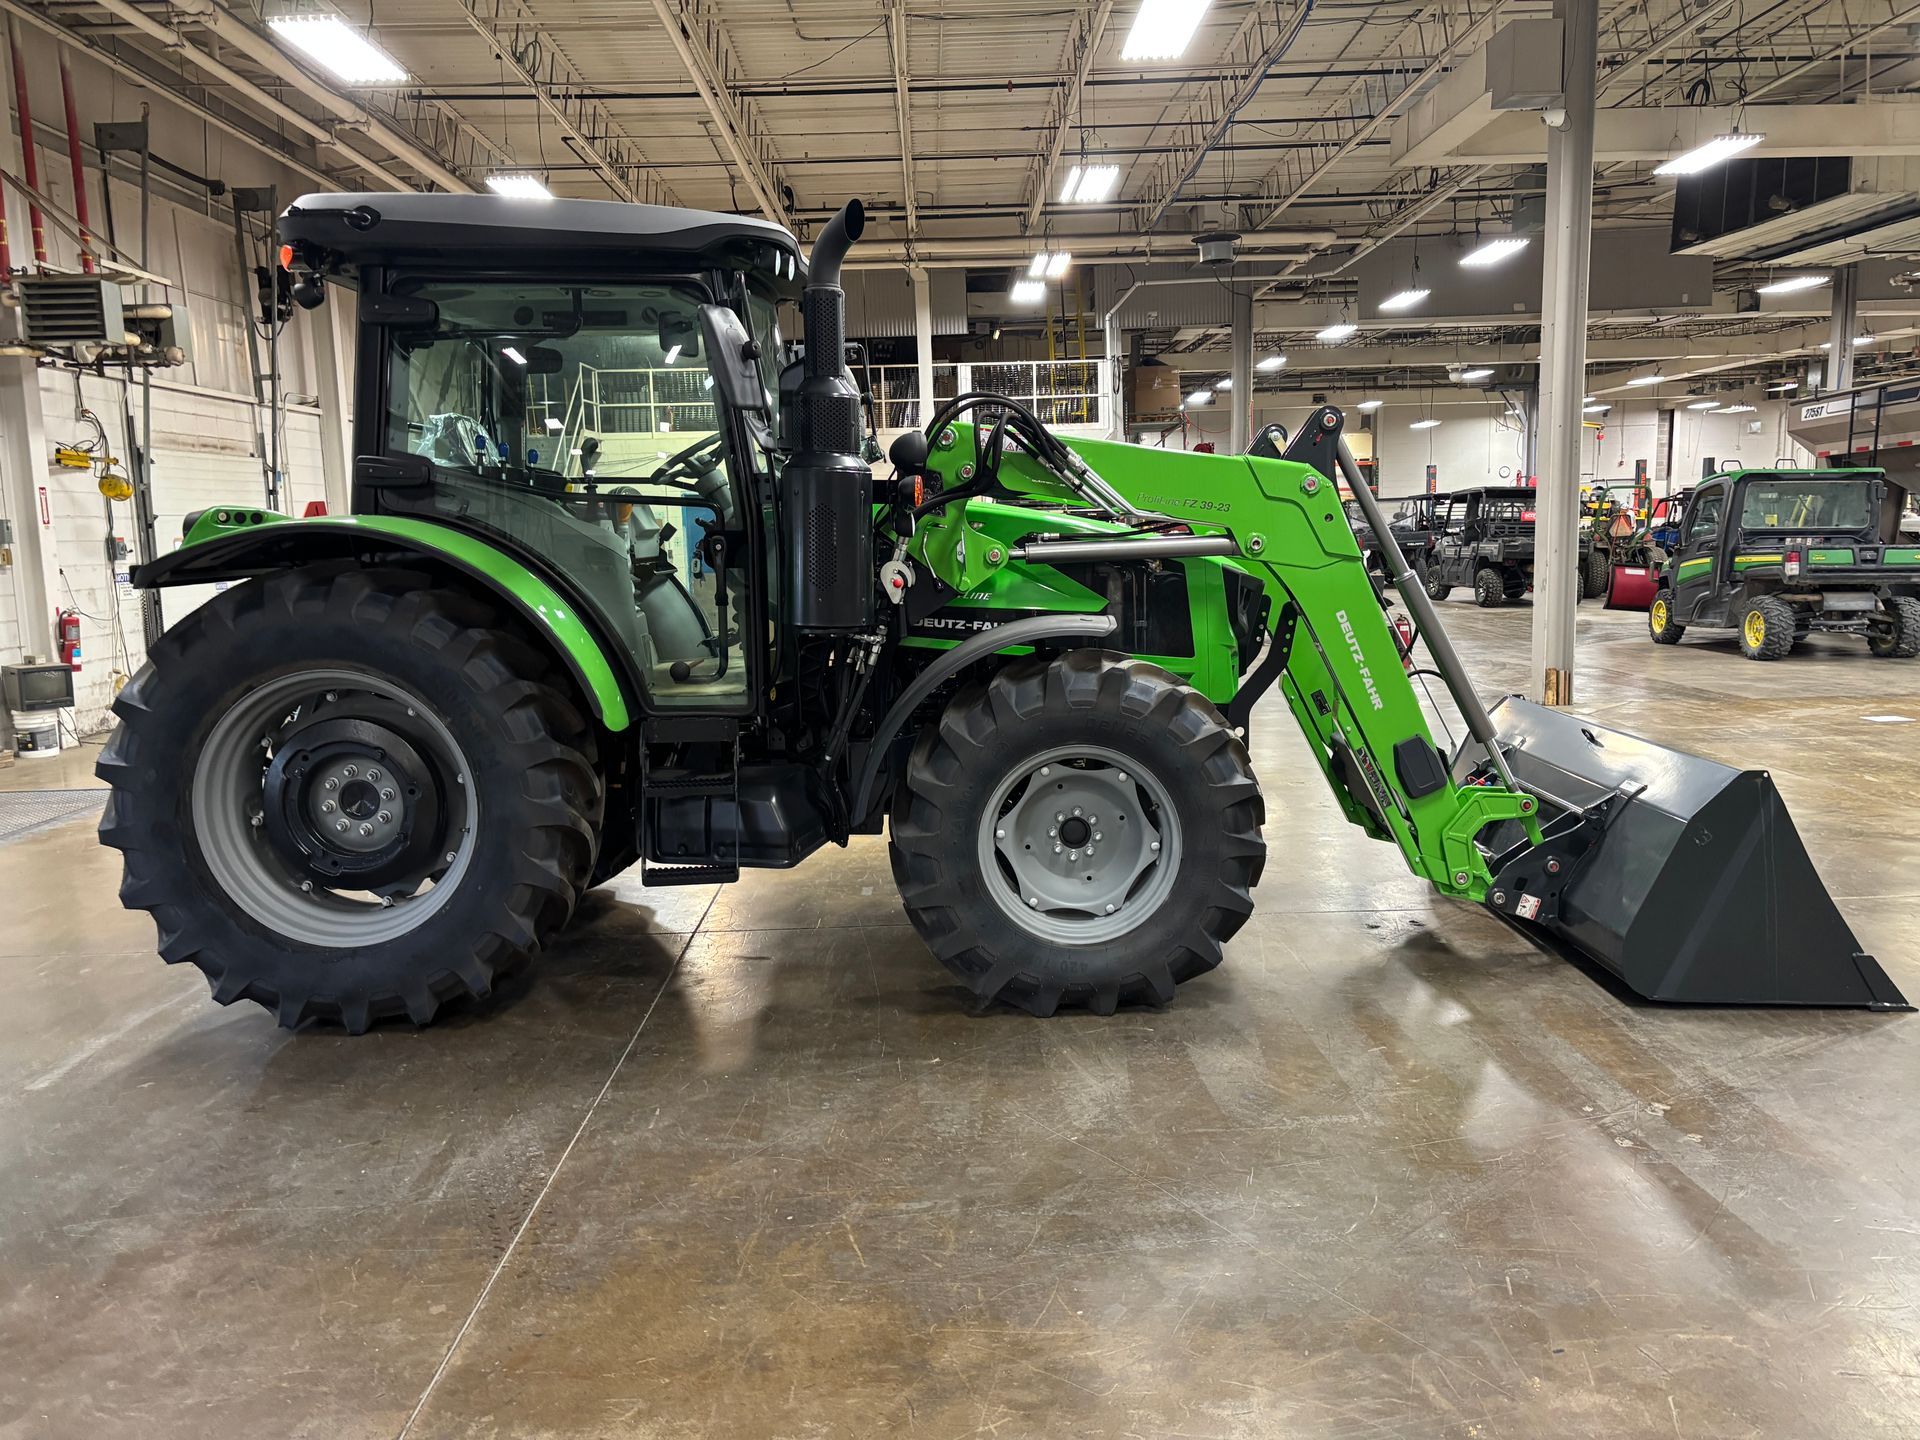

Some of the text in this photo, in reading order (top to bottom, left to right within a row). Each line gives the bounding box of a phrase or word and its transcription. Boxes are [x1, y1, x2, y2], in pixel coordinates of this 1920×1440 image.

[1804, 405, 1824, 419] 275ST
[1182, 498, 1199, 509] FZ
[1199, 500, 1231, 513] 39-23
[913, 617, 1005, 631] EUTZ-FA
[1336, 609, 1383, 711] DEUTZ-FAHR
